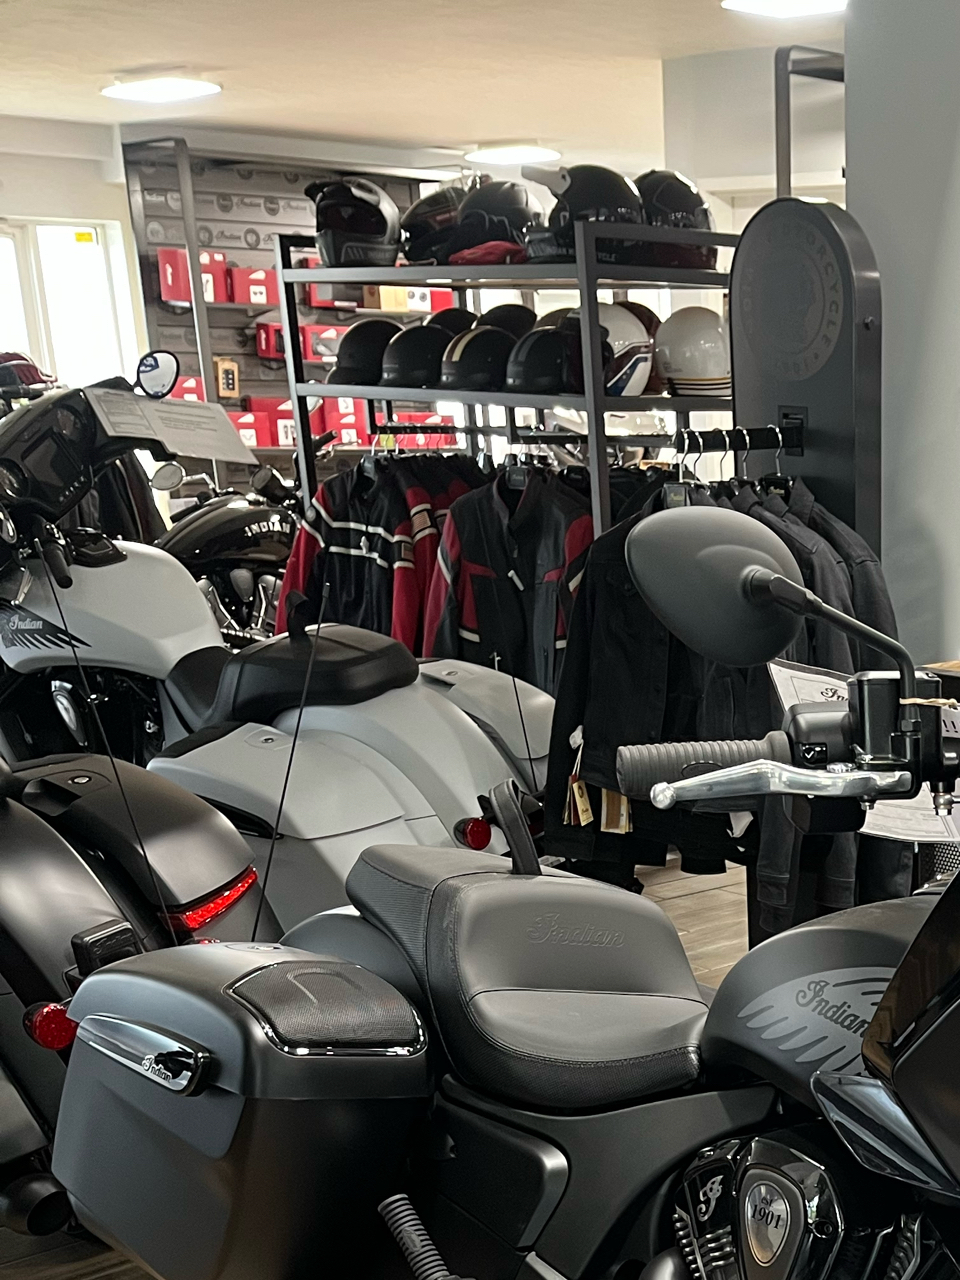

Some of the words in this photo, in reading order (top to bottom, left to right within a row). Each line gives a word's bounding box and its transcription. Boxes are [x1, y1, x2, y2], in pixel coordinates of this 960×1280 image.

[244, 521, 290, 537] INDIAN
[8, 614, 43, 630] Indian
[526, 911, 625, 948] Indian
[795, 980, 871, 1038] Indian
[142, 1055, 172, 1083] Indian
[752, 1204, 782, 1229] 1901
